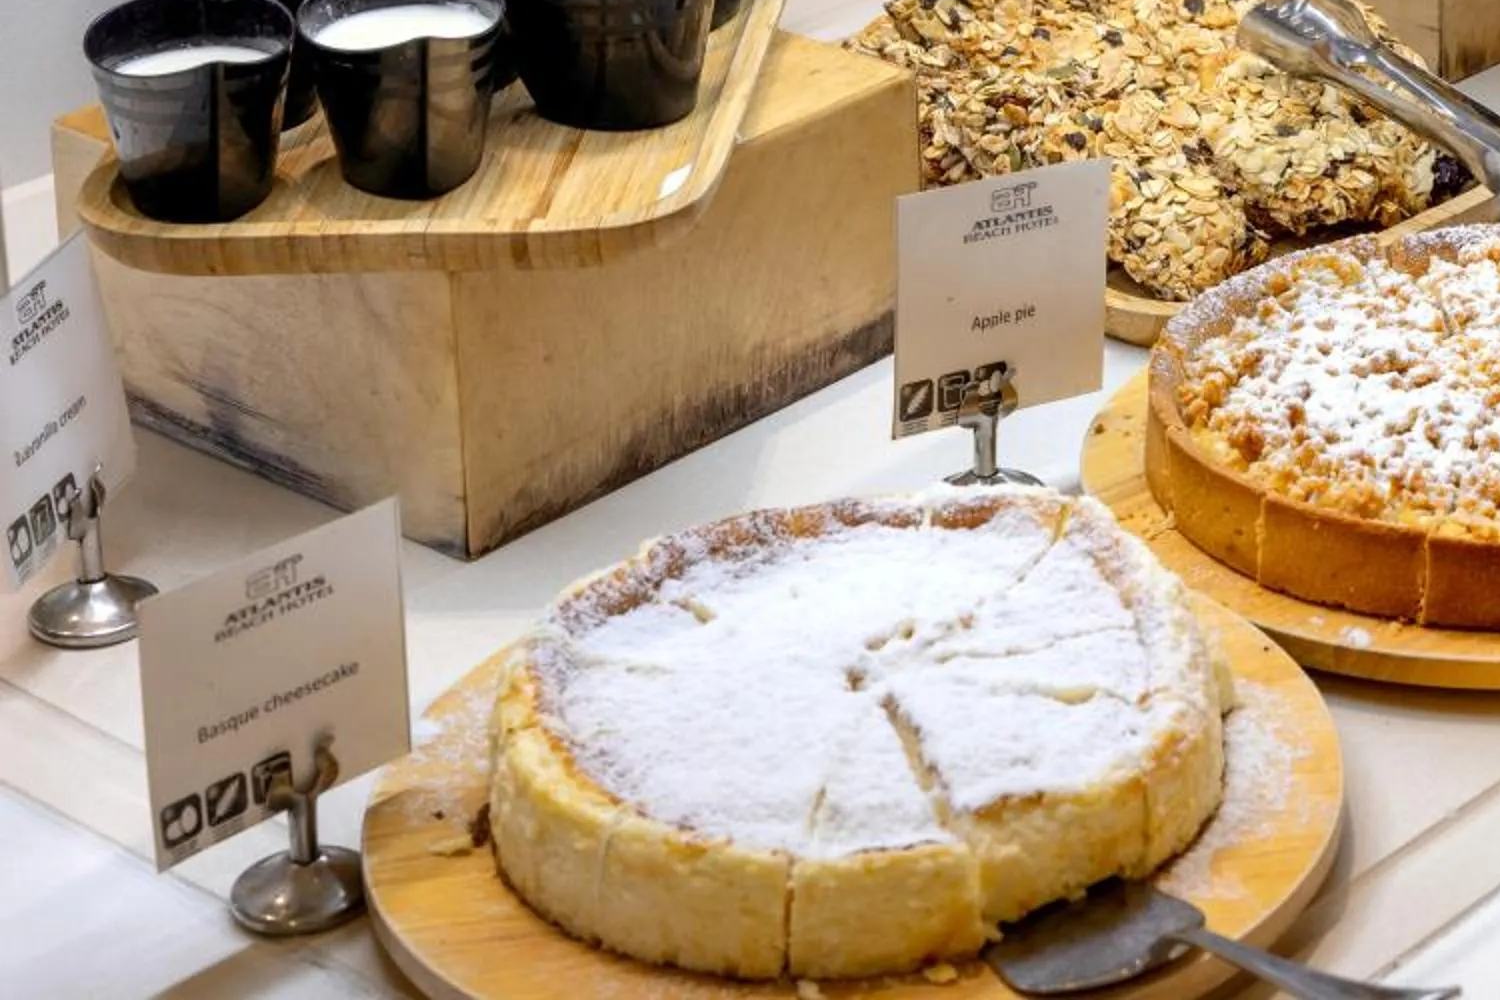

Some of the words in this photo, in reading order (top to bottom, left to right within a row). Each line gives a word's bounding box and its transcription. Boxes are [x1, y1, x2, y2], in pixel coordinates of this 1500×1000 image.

[963, 226, 1012, 244] BEACH
[1015, 215, 1059, 233] HOTEL
[972, 204, 1054, 232] ATLANTIS
[12, 299, 64, 349] ATLANTIS
[971, 309, 1011, 333] Apple
[1014, 304, 1036, 325] pie
[214, 610, 274, 643] BEACH
[279, 584, 334, 616] HOTEL
[224, 575, 326, 626] ATLANTIS
[197, 706, 260, 744] Basque
[263, 662, 359, 713] cheesecake
